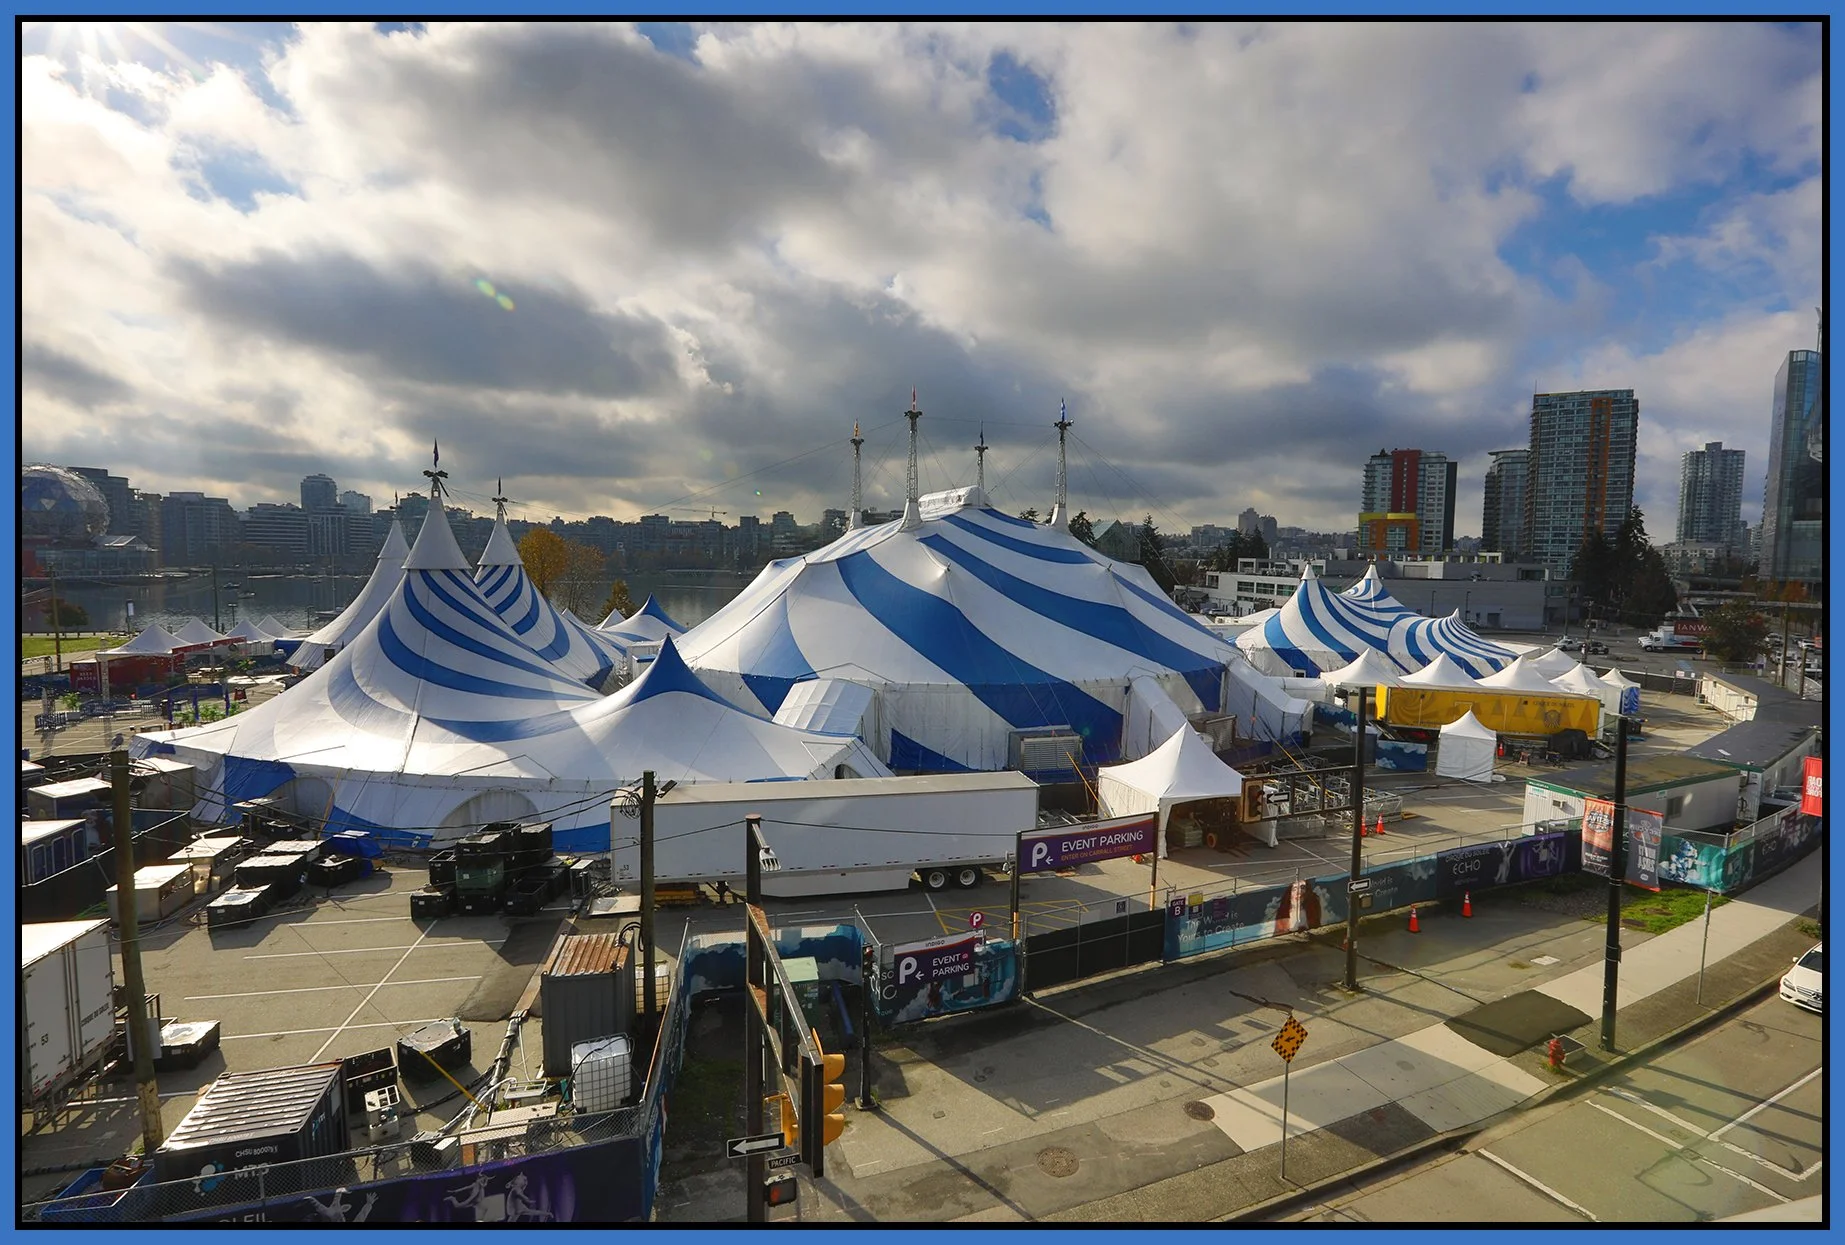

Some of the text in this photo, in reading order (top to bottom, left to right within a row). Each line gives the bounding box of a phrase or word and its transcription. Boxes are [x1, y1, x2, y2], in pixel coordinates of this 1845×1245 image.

[1061, 830, 1143, 852] EVENT PARKING
[1061, 852, 1079, 861] ENTER
[1114, 844, 1133, 853] STREET
[1453, 859, 1480, 875] ECHO
[1174, 906, 1181, 916] B
[932, 953, 961, 967] EVENT
[932, 962, 970, 978] PARKING
[41, 1033, 49, 1046] 53
[771, 1156, 796, 1168] PACIFIC
